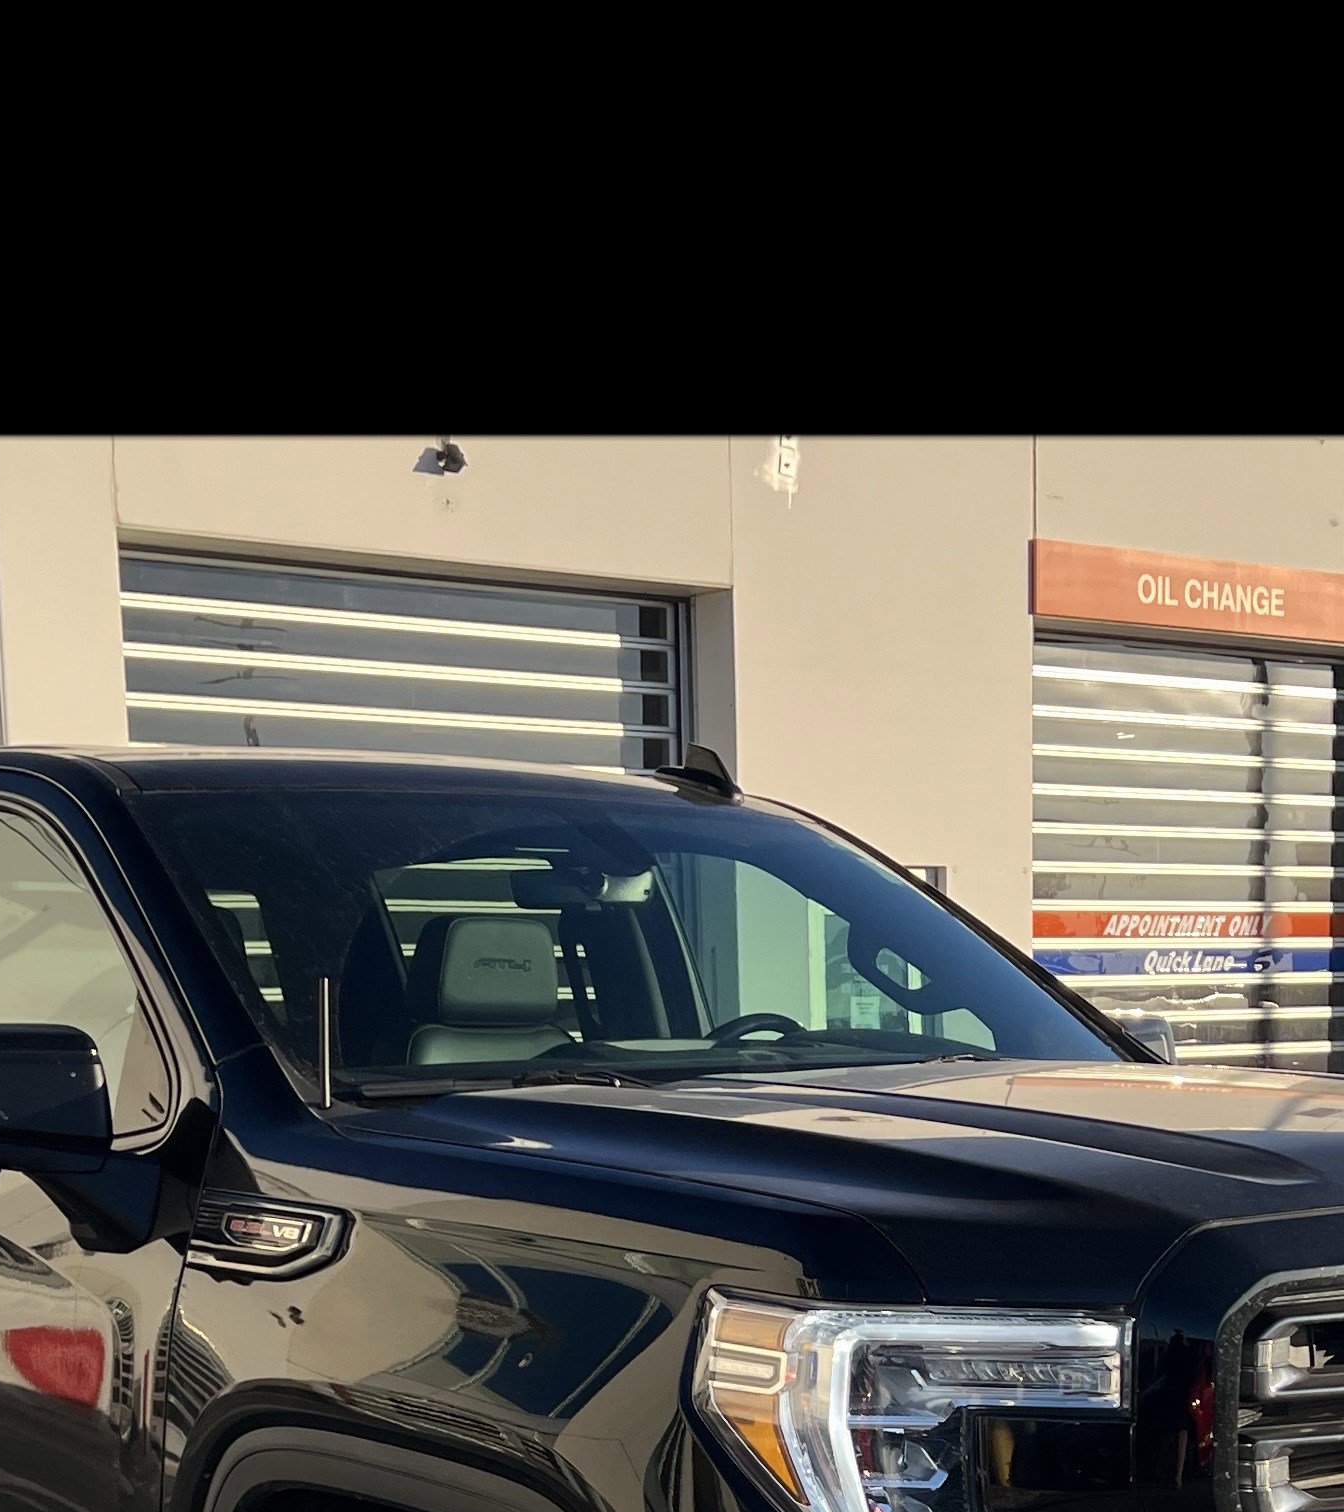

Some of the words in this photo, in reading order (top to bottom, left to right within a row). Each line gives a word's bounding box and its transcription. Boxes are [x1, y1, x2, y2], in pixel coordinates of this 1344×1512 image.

[1137, 572, 1178, 608] OIL
[1184, 578, 1286, 618] CHANGE
[1103, 913, 1227, 938] APPOINTMENT
[1228, 913, 1273, 937] ONLY
